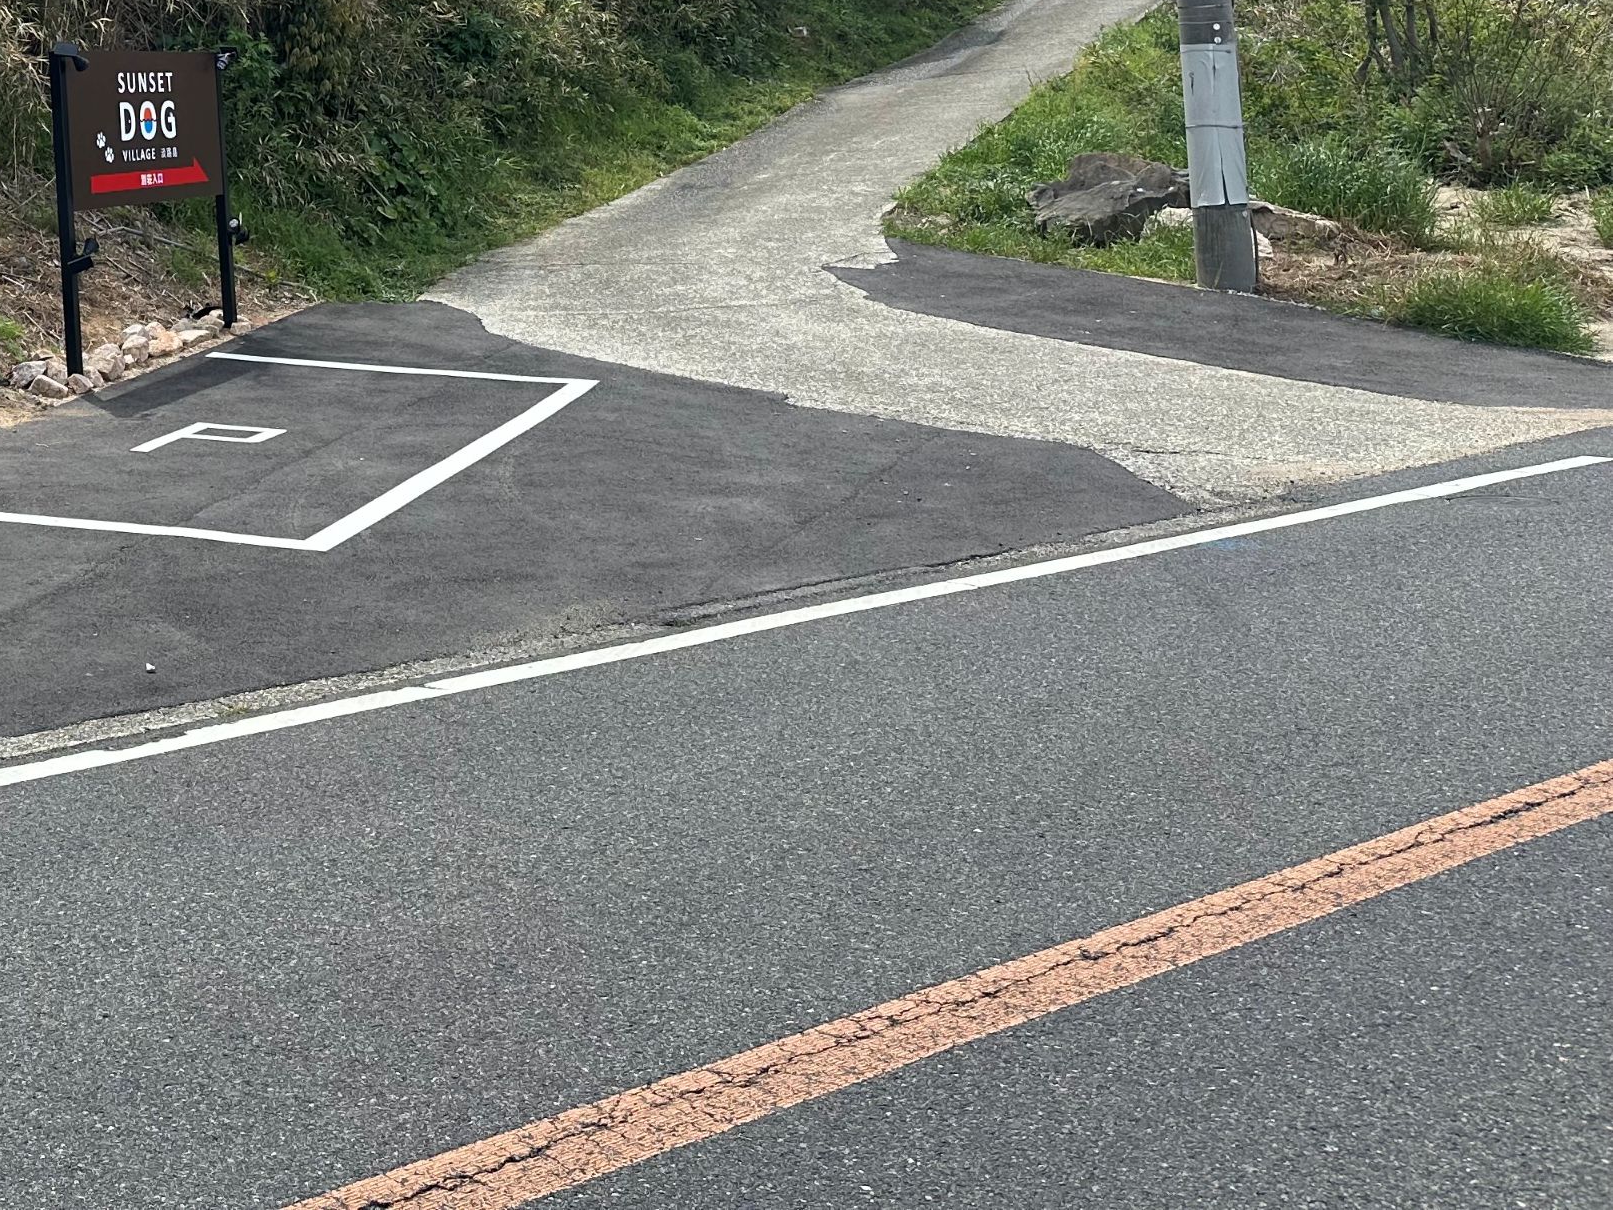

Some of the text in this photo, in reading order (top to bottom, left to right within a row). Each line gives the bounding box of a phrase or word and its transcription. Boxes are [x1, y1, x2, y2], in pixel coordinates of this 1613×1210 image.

[117, 72, 173, 94] SUNSET
[119, 100, 177, 142] DOG
[122, 148, 156, 162] VILLAGE
[129, 421, 288, 453] P
